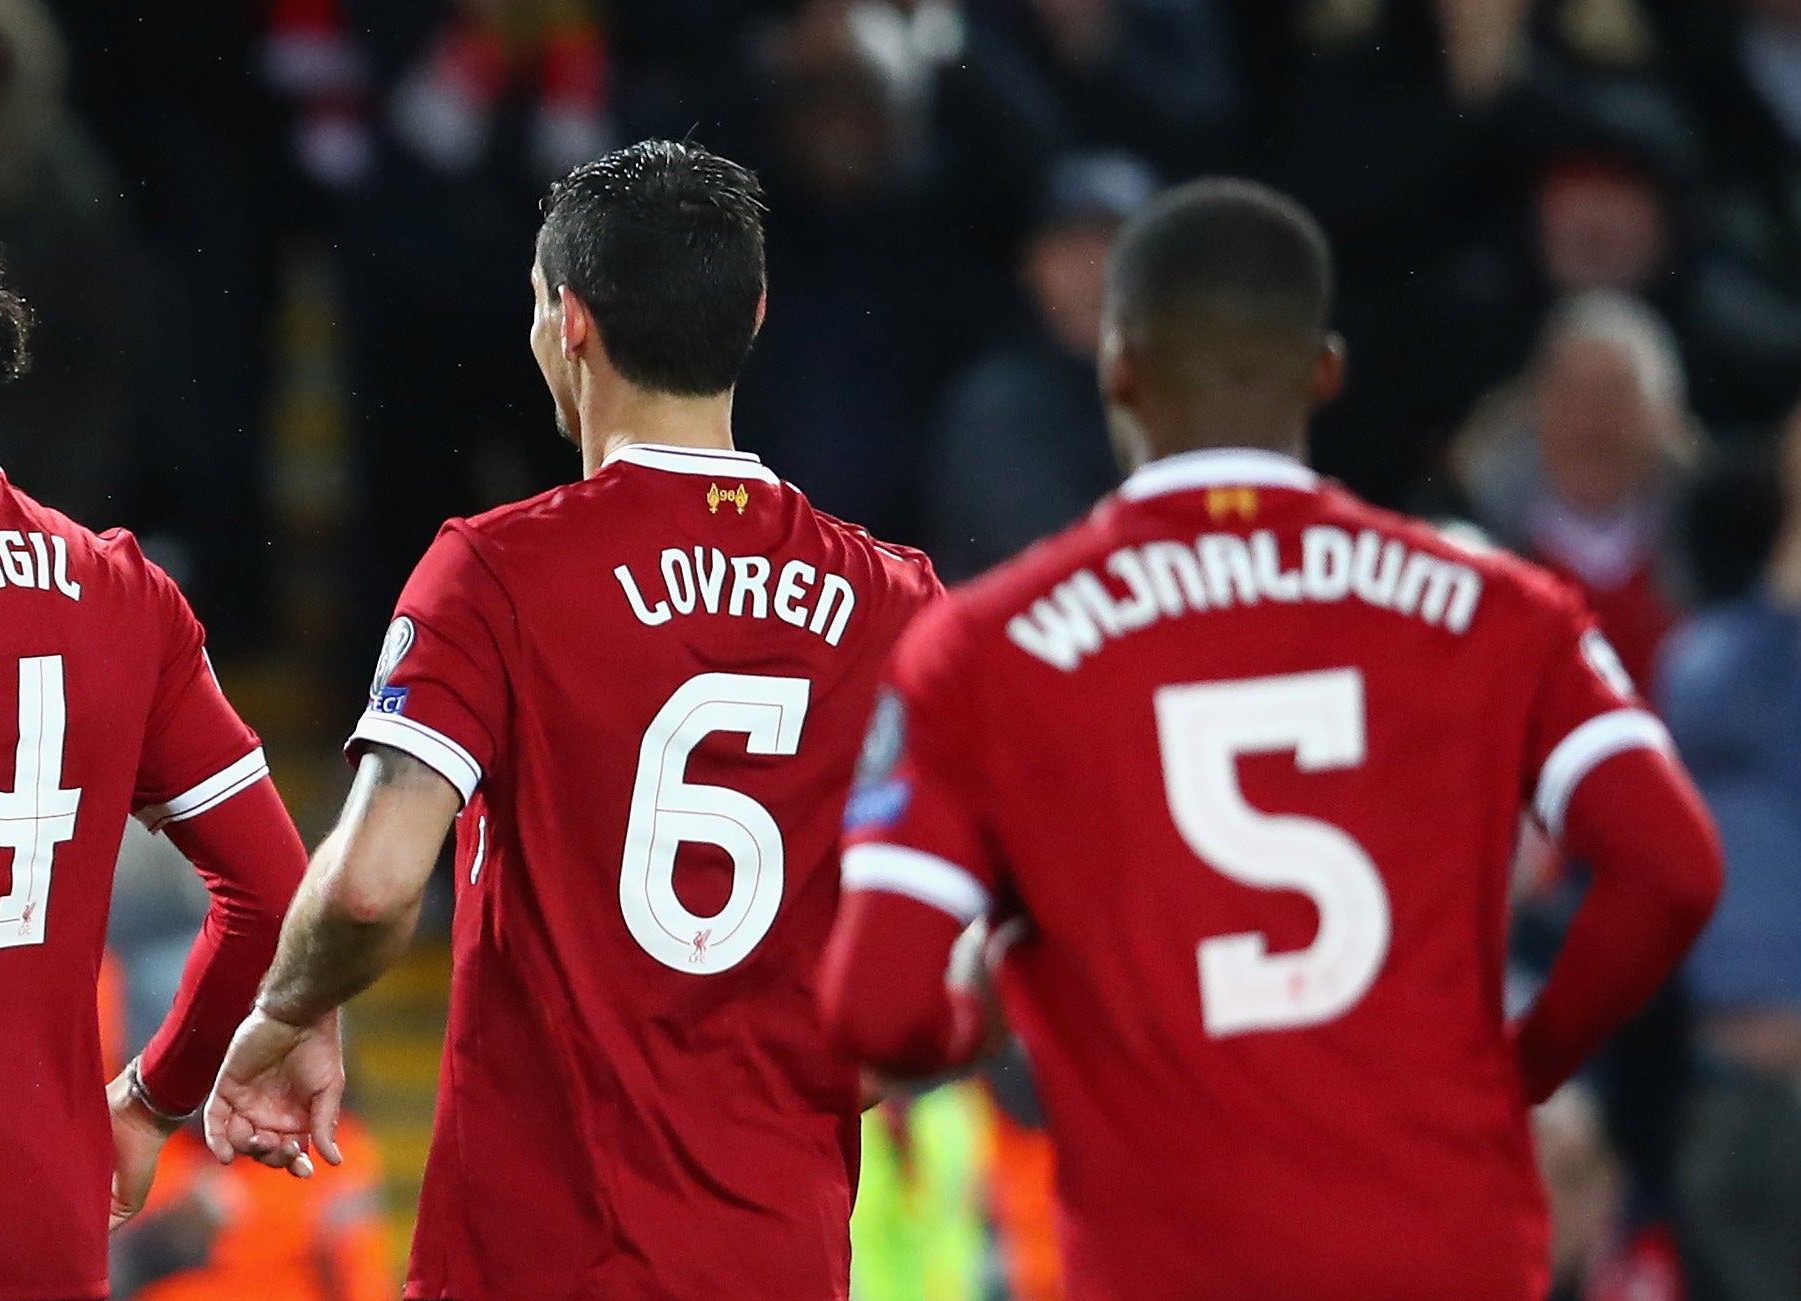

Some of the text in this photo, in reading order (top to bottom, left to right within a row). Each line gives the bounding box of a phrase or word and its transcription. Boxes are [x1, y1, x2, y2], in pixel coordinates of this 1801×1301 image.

[613, 545, 856, 648] LOVREN
[1006, 525, 1483, 672] WIJNALDUM
[618, 671, 812, 976] 6
[1152, 666, 1392, 1040] 5
